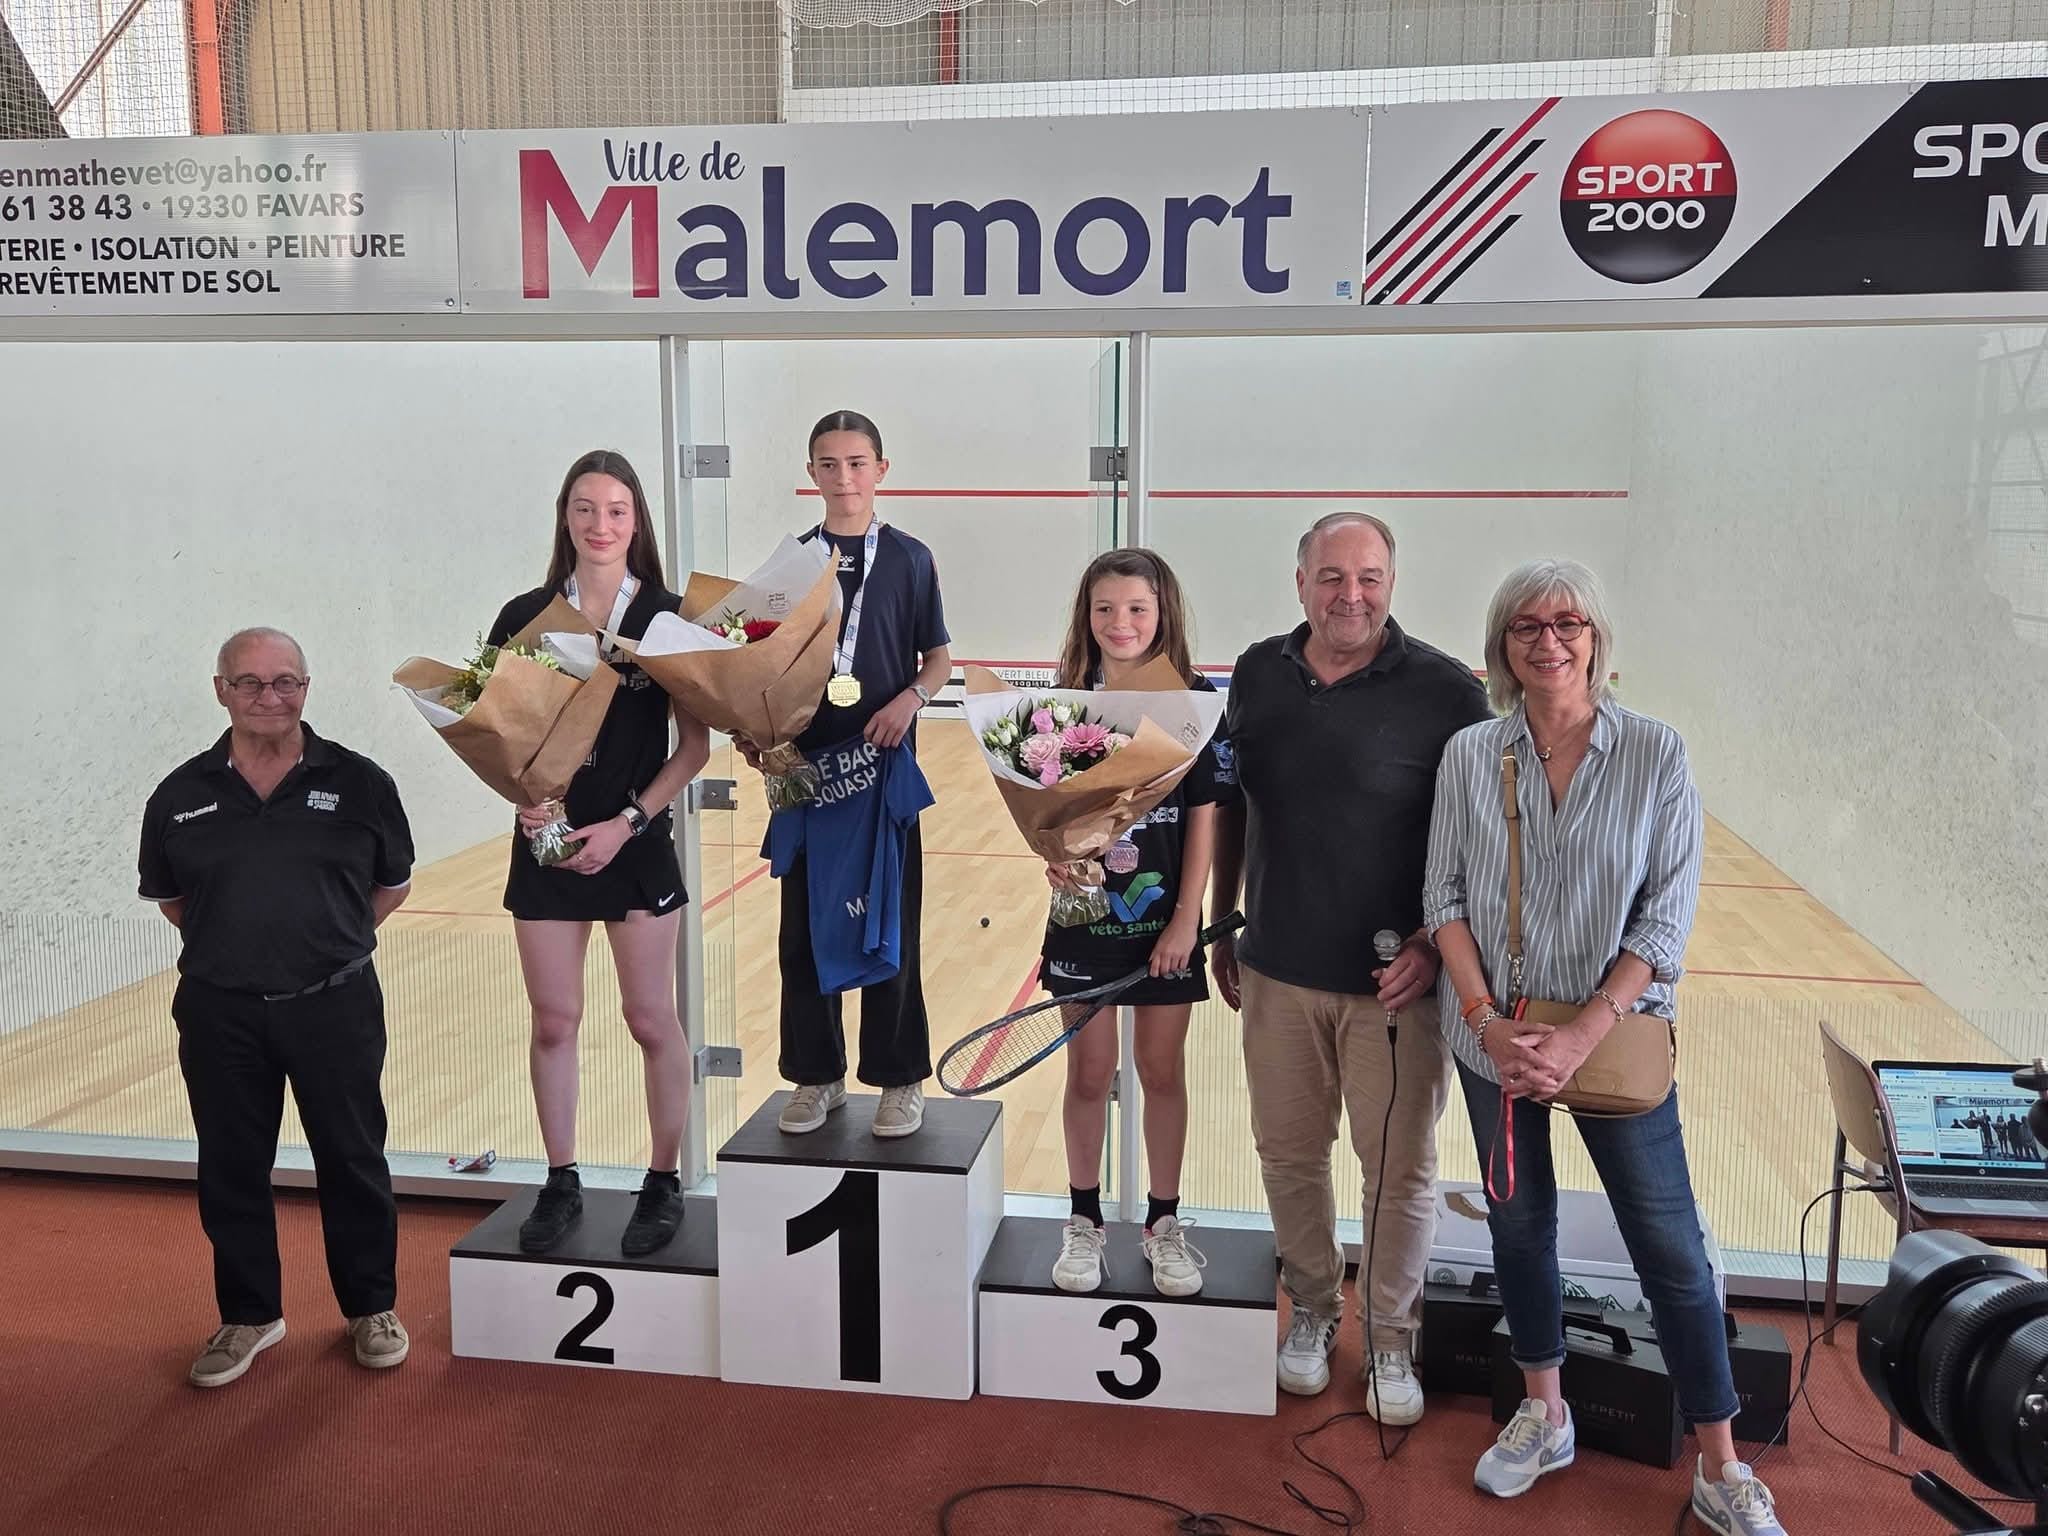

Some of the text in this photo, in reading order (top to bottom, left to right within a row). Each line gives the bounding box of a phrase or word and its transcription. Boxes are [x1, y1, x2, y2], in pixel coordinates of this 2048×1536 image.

[0, 153, 327, 193] enmathevet@yahoo.fr
[602, 138, 746, 183] Ville de
[1576, 161, 1723, 197] SPORT
[1, 192, 365, 222] 61 38 43 19330 FAVARS
[519, 148, 1293, 301] Malemort
[1587, 200, 1706, 232] 2000
[91, 235, 239, 261] ISOLATION
[266, 233, 406, 259] PEINTURE
[0, 266, 281, 295] REVÊTEMENT DE SOL
[1025, 670, 1049, 680] BLEU
[836, 742, 881, 774] BAR
[785, 1170, 881, 1384] 1
[553, 1271, 615, 1365] 2
[1095, 1303, 1161, 1400] 3
